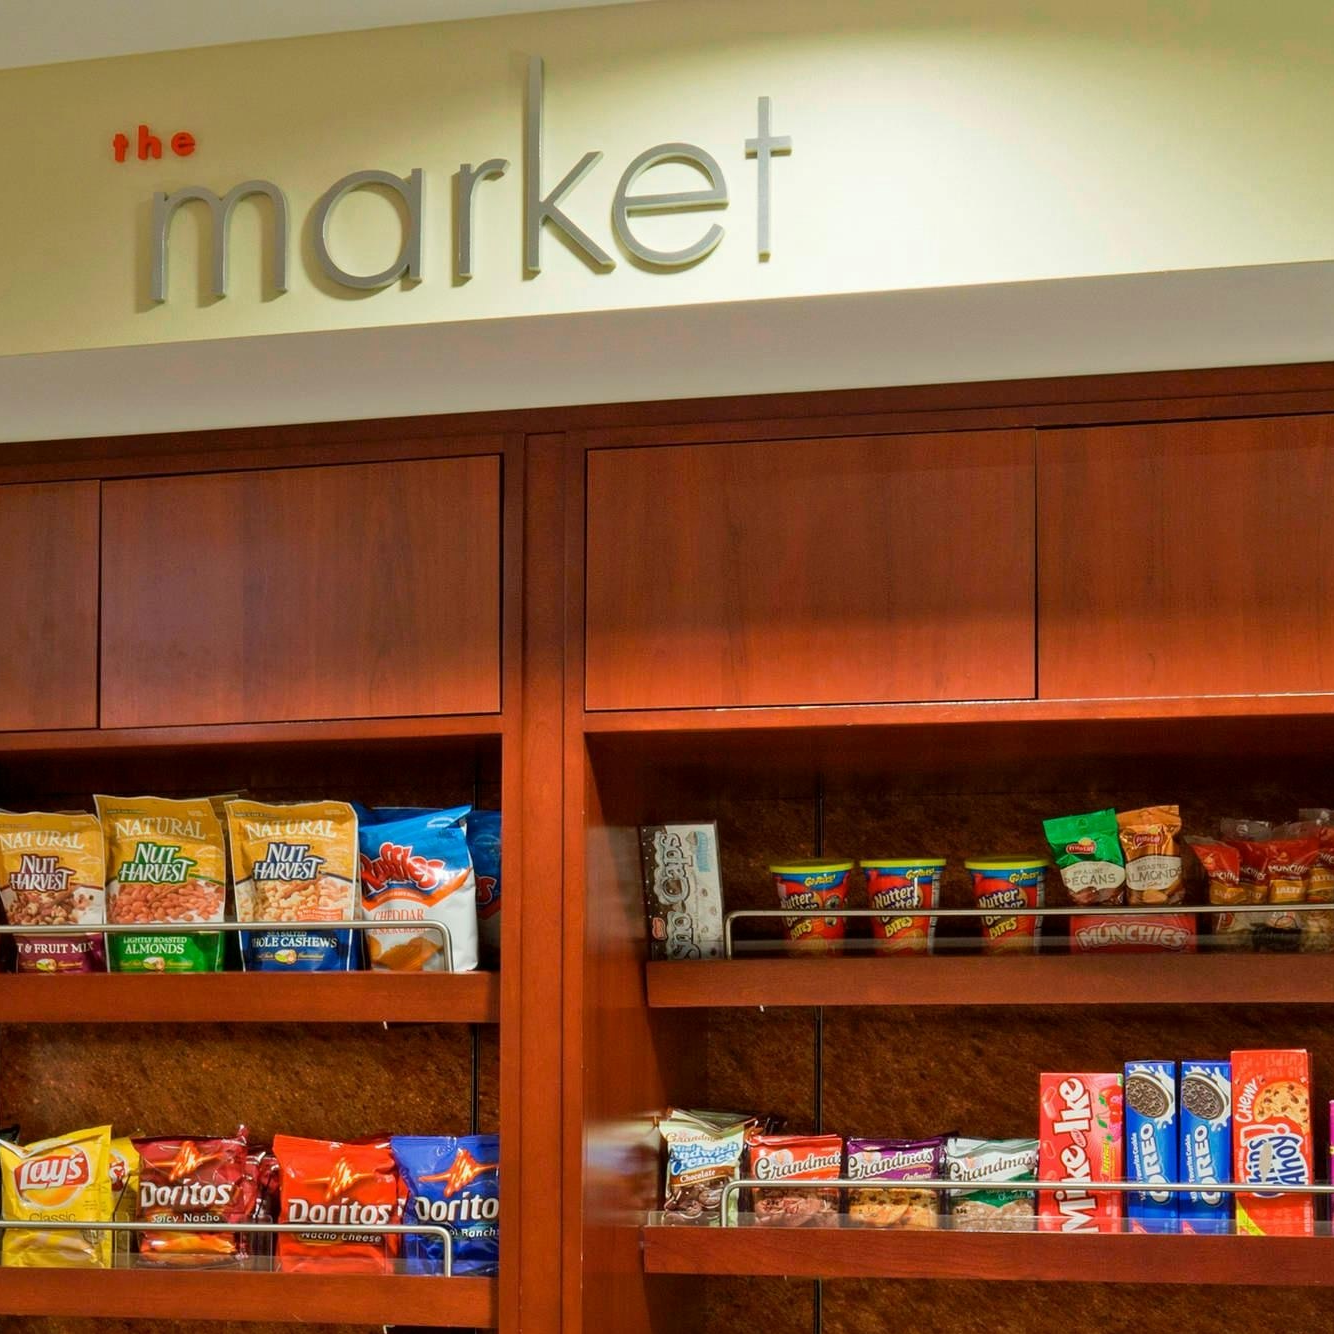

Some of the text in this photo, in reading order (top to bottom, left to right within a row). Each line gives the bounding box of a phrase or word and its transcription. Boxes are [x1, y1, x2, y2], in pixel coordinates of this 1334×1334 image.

[113, 125, 196, 162] the
[151, 56, 792, 304] market
[0, 831, 85, 849] NATURAL
[116, 817, 206, 840] NATURAL
[245, 820, 337, 840] NATURAL
[21, 855, 60, 874] NUT
[134, 843, 180, 865] NUT
[266, 843, 311, 864] NUT
[9, 868, 75, 892] HARVEST
[118, 860, 195, 883] HARVEST
[253, 857, 324, 881] HARVEST
[874, 886, 916, 909] Nutter
[979, 889, 1018, 909] Nutter
[374, 909, 424, 920] CHEDDAR
[885, 916, 913, 937] BITES
[989, 917, 1017, 940] BITES
[1077, 923, 1189, 949] MUNCHIES
[34, 941, 95, 954] FRUIT MIX
[123, 936, 187, 944] LIGHTLY ROASTED
[125, 943, 185, 954] ALMONDS
[280, 938, 337, 948] CASHEWS
[1053, 1078, 1093, 1134] Ike
[19, 1152, 85, 1191] Lay's
[755, 1150, 842, 1180] Grandma's
[848, 1149, 935, 1179] Grandma's
[948, 1153, 1034, 1181] Grandma's
[1140, 1123, 1171, 1204] OREO
[1194, 1125, 1223, 1205] OREO
[680, 1169, 716, 1184] Chocolate
[140, 1178, 233, 1208] Doritos
[29, 1212, 75, 1222] Classic
[183, 1213, 220, 1223] Nacho
[287, 1198, 392, 1225] Doritos
[342, 1232, 382, 1243] Cheese
